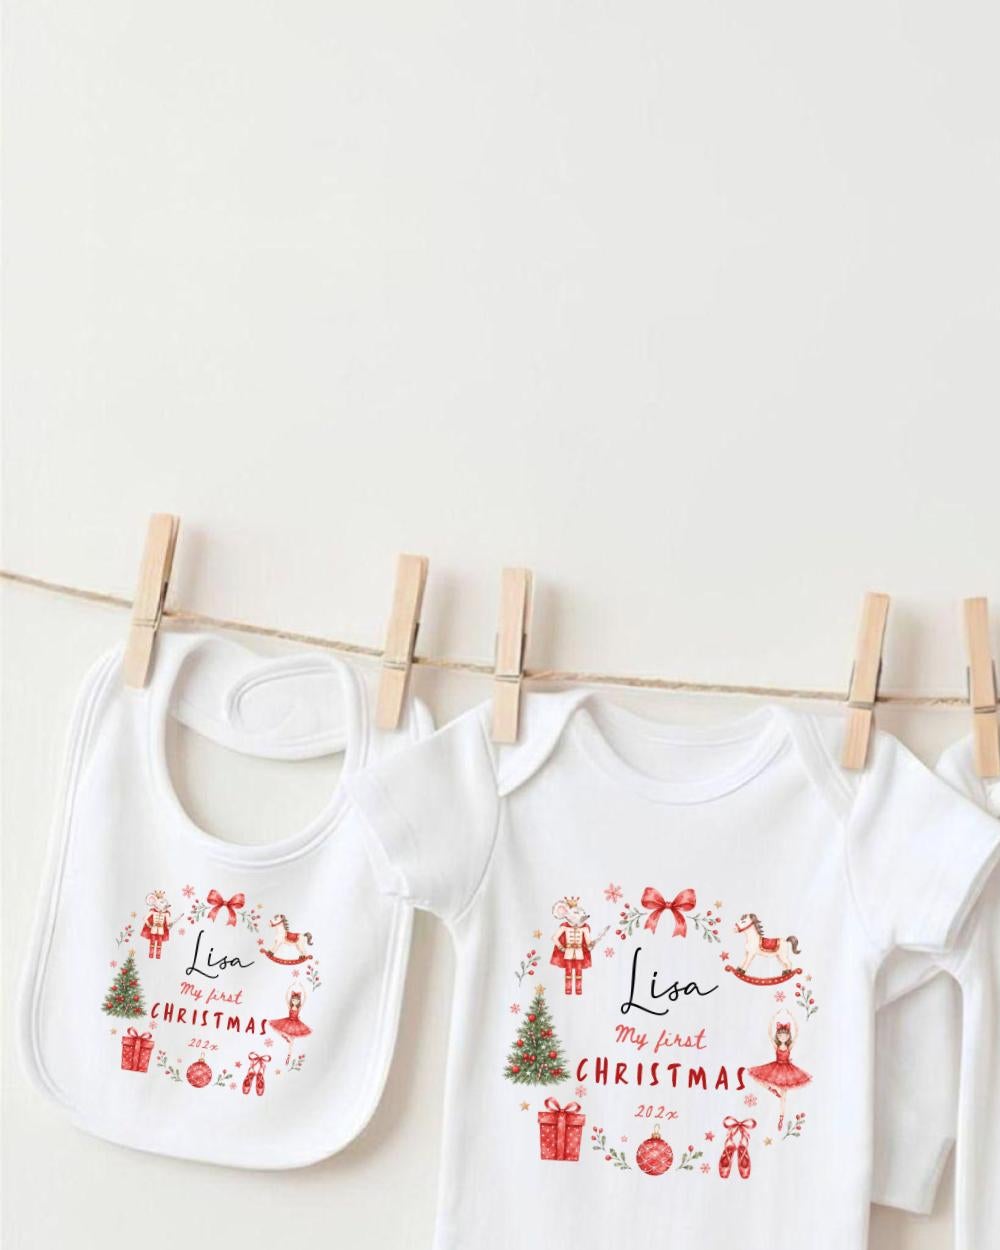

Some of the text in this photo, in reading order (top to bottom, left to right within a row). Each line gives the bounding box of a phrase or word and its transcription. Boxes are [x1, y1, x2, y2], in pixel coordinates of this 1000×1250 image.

[185, 929, 255, 979] Lisa
[180, 981, 244, 1005] My first
[620, 947, 719, 1015] Lisa
[151, 1002, 267, 1036] CHRISTMAS
[187, 1038, 219, 1051] 202x
[615, 1024, 708, 1054] My first
[576, 1057, 747, 1091] CHRISTMAS
[633, 1104, 679, 1120] 202x
